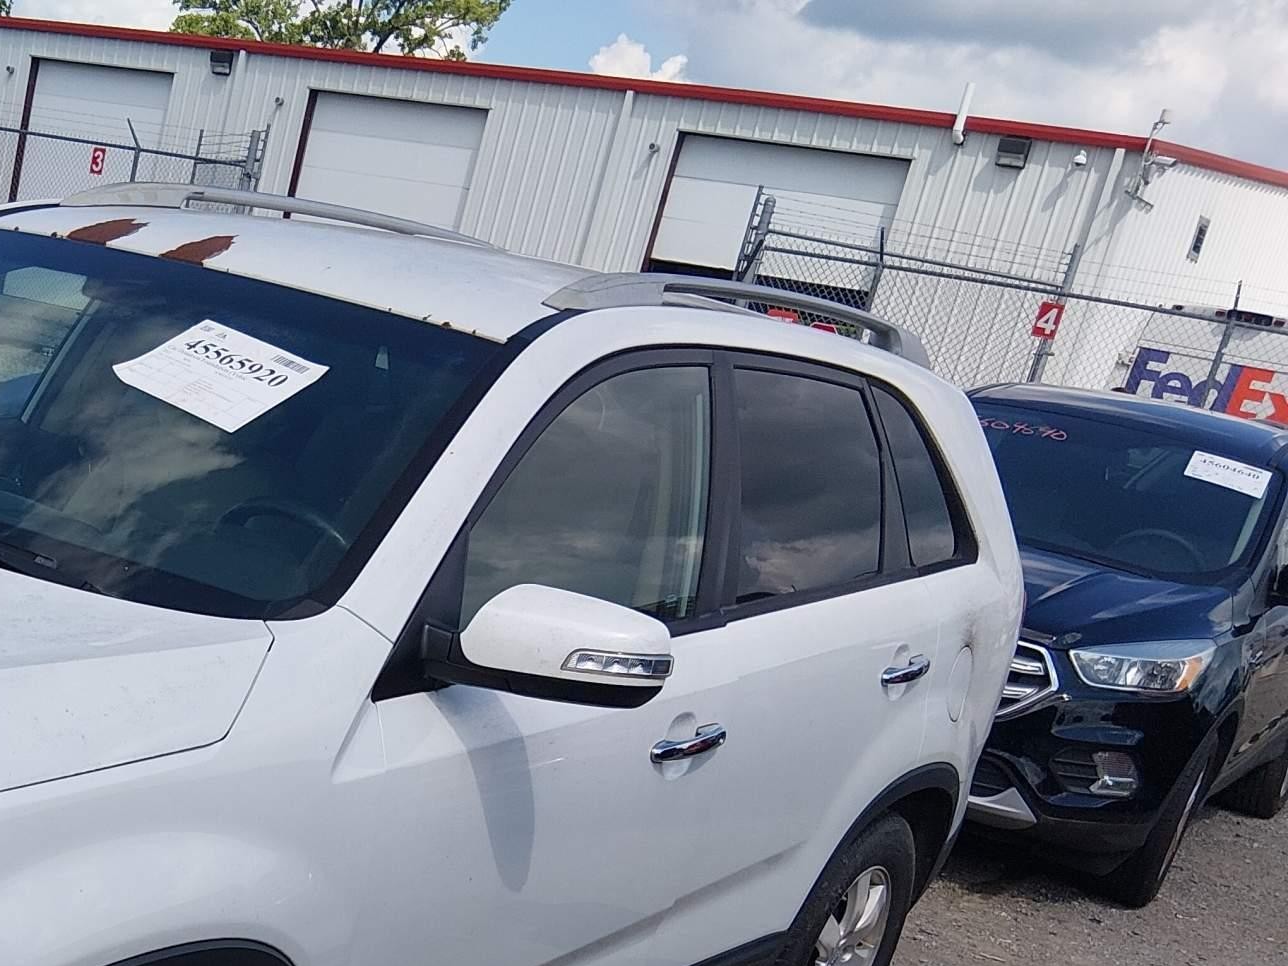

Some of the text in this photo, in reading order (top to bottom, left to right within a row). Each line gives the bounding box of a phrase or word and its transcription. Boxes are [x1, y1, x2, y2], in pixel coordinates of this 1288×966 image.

[92, 150, 104, 172] 3
[1035, 307, 1059, 335] 4
[184, 339, 289, 388] 45565920
